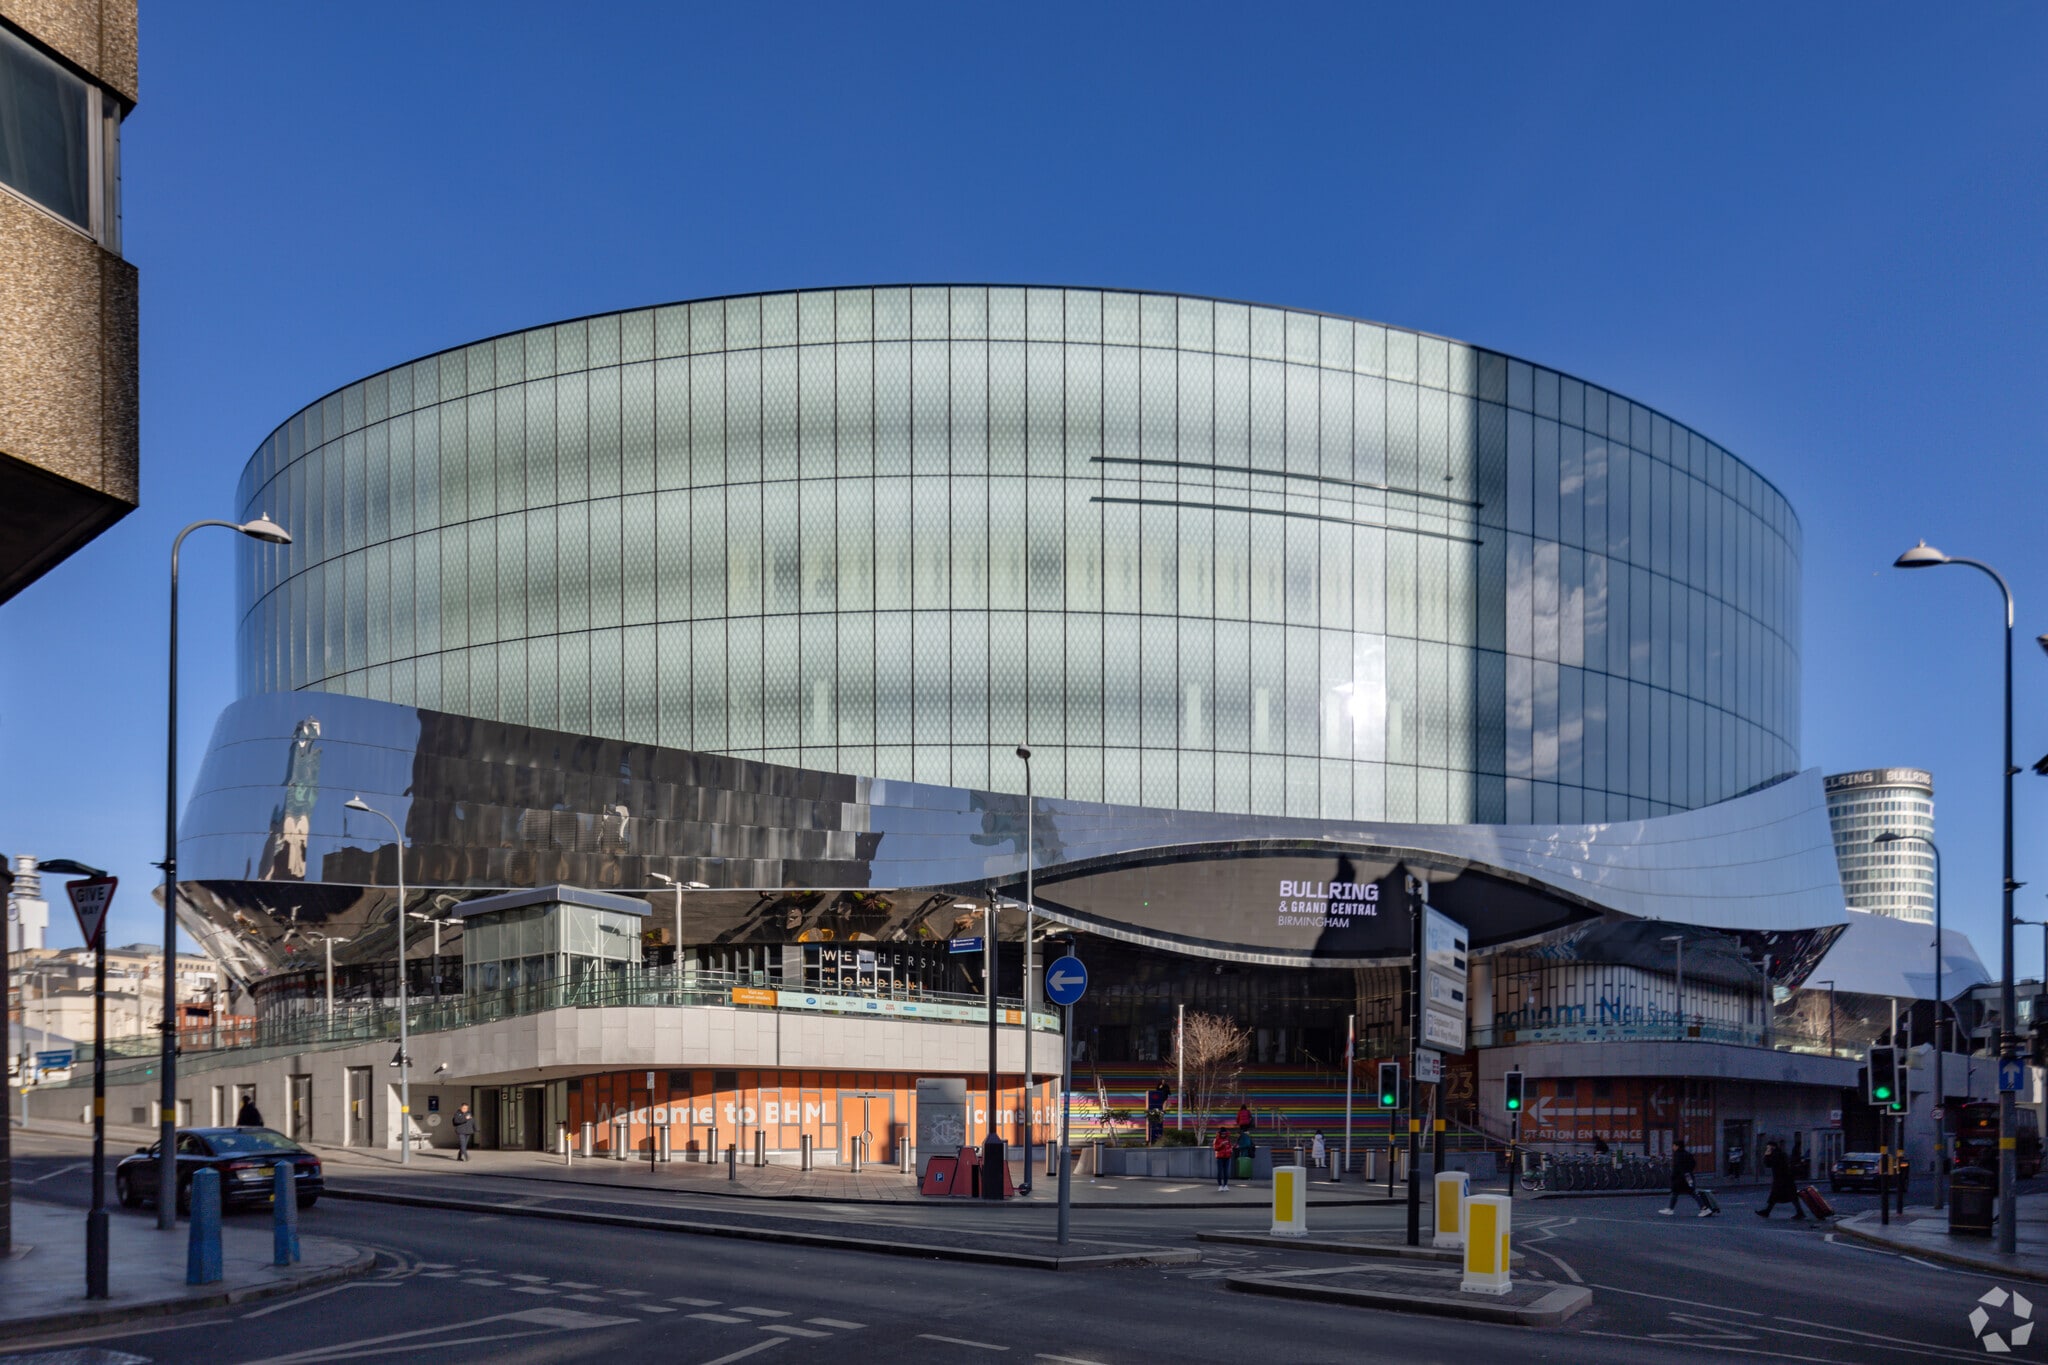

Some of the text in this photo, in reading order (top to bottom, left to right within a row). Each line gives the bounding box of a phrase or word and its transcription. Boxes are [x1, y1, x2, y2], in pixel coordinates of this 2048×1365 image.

[1885, 770, 1931, 785] BULLRING
[76, 887, 105, 902] GIVE
[1279, 880, 1380, 901] BULLRING
[81, 906, 100, 915] WAY
[1278, 900, 1378, 917] & GRAND CENTRAL
[1278, 915, 1351, 928] BIRMINGHAM
[826, 976, 917, 990] LONDON
[593, 1101, 827, 1125] Welcome to BHM
[1523, 1129, 1643, 1140] STATION ENTRANCE
[936, 1173, 943, 1181] P
